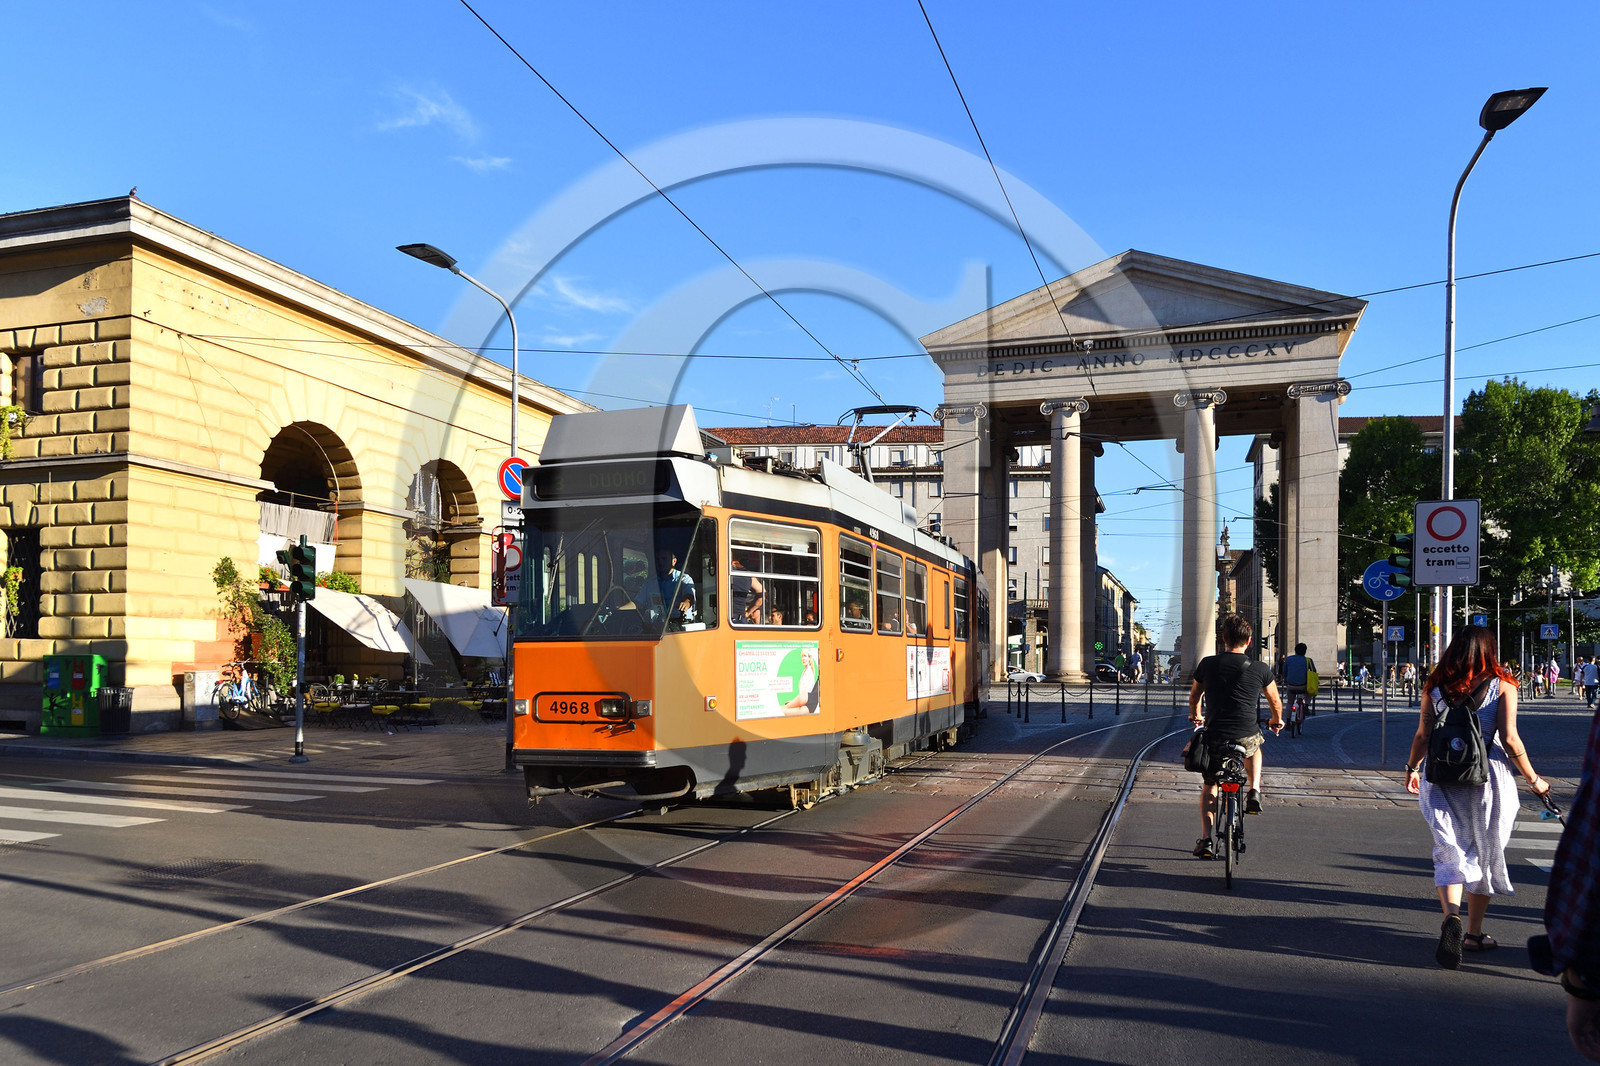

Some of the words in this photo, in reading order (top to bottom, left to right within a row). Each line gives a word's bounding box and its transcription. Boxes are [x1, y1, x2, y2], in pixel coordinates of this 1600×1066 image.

[977, 359, 1054, 379] DEDIC
[1076, 352, 1146, 372] ANNO
[1167, 341, 1299, 364] MDCCCXV
[589, 471, 646, 490] DUOMO
[1423, 544, 1470, 554] eccetto
[1426, 558, 1455, 566] tram
[739, 662, 767, 672] DVORA
[550, 701, 590, 714] 4968
